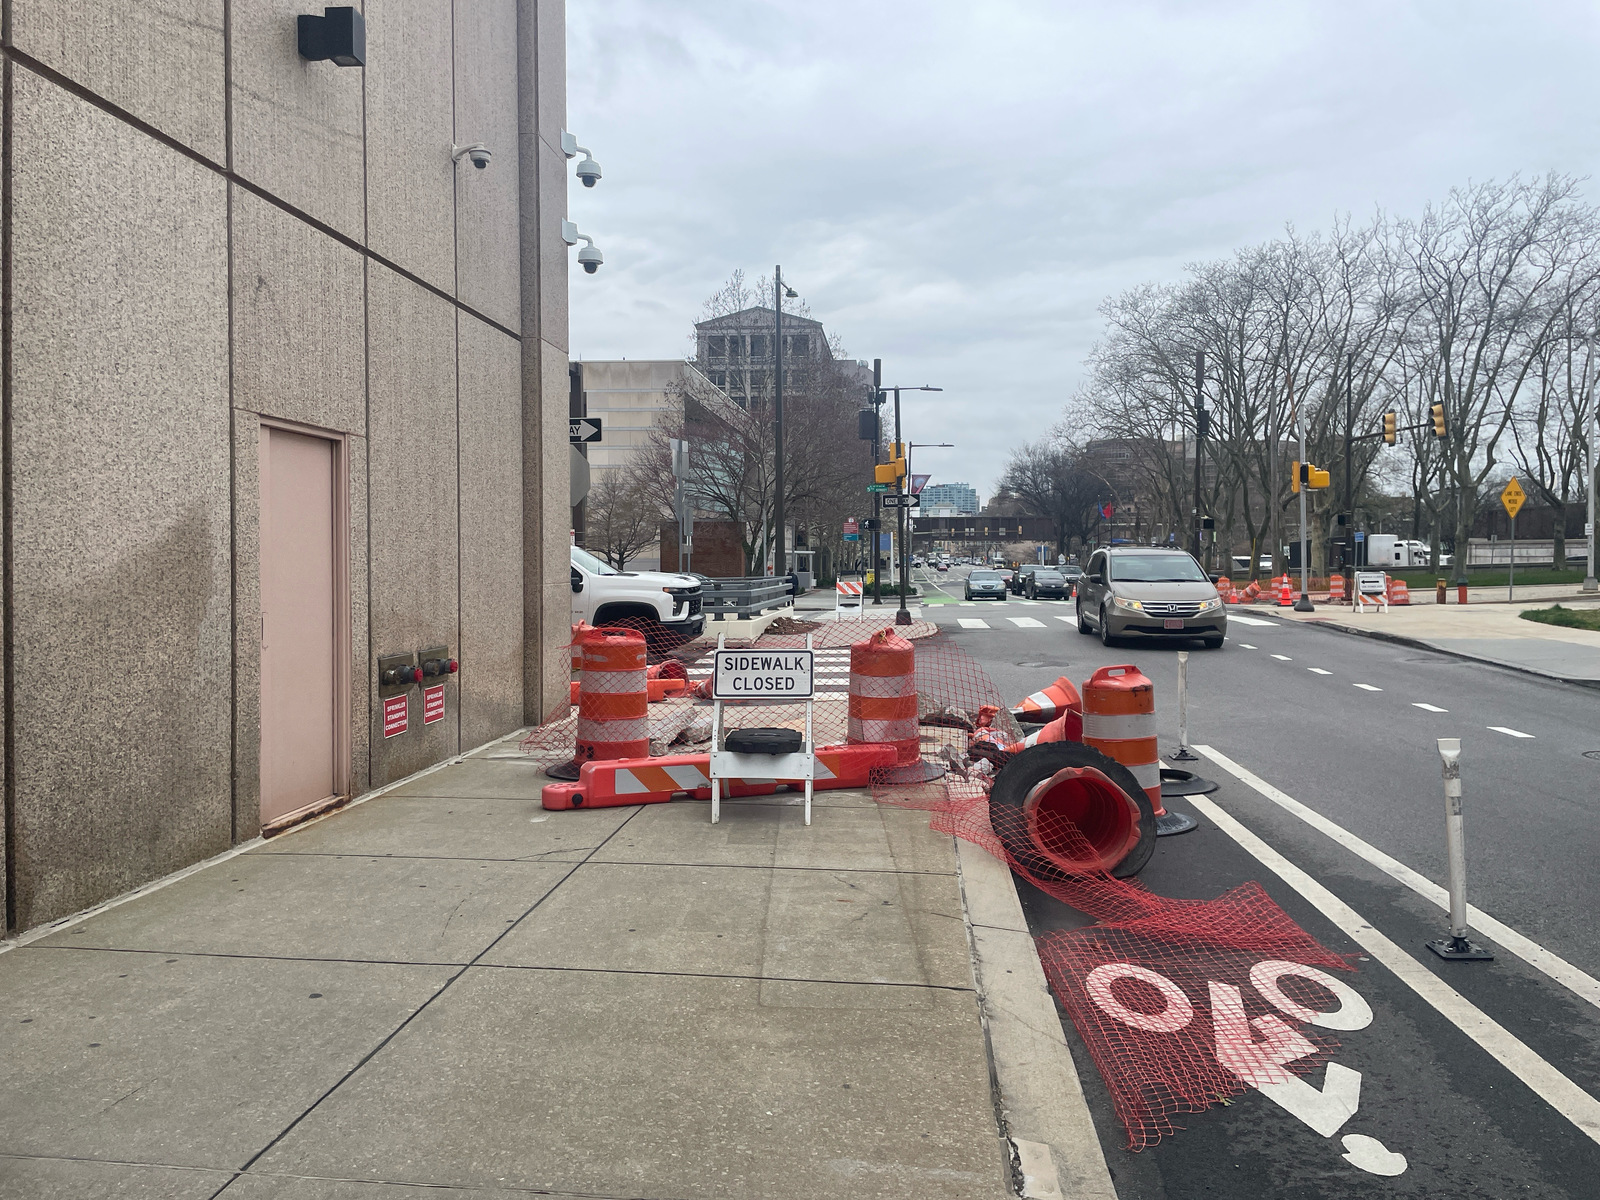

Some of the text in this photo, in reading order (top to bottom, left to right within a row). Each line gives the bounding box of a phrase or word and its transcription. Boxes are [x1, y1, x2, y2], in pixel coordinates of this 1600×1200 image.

[570, 426, 580, 435] AY
[724, 657, 804, 671] SIDEWALK
[732, 677, 795, 691] CLOSED
[427, 691, 442, 700] SPRINKLER
[387, 702, 406, 712] SPRINKLER
[427, 700, 442, 708] STANDPIPE
[387, 711, 406, 721] STANDPIPE
[426, 707, 444, 717] CONNECTION
[386, 720, 407, 730] CONNECTION
